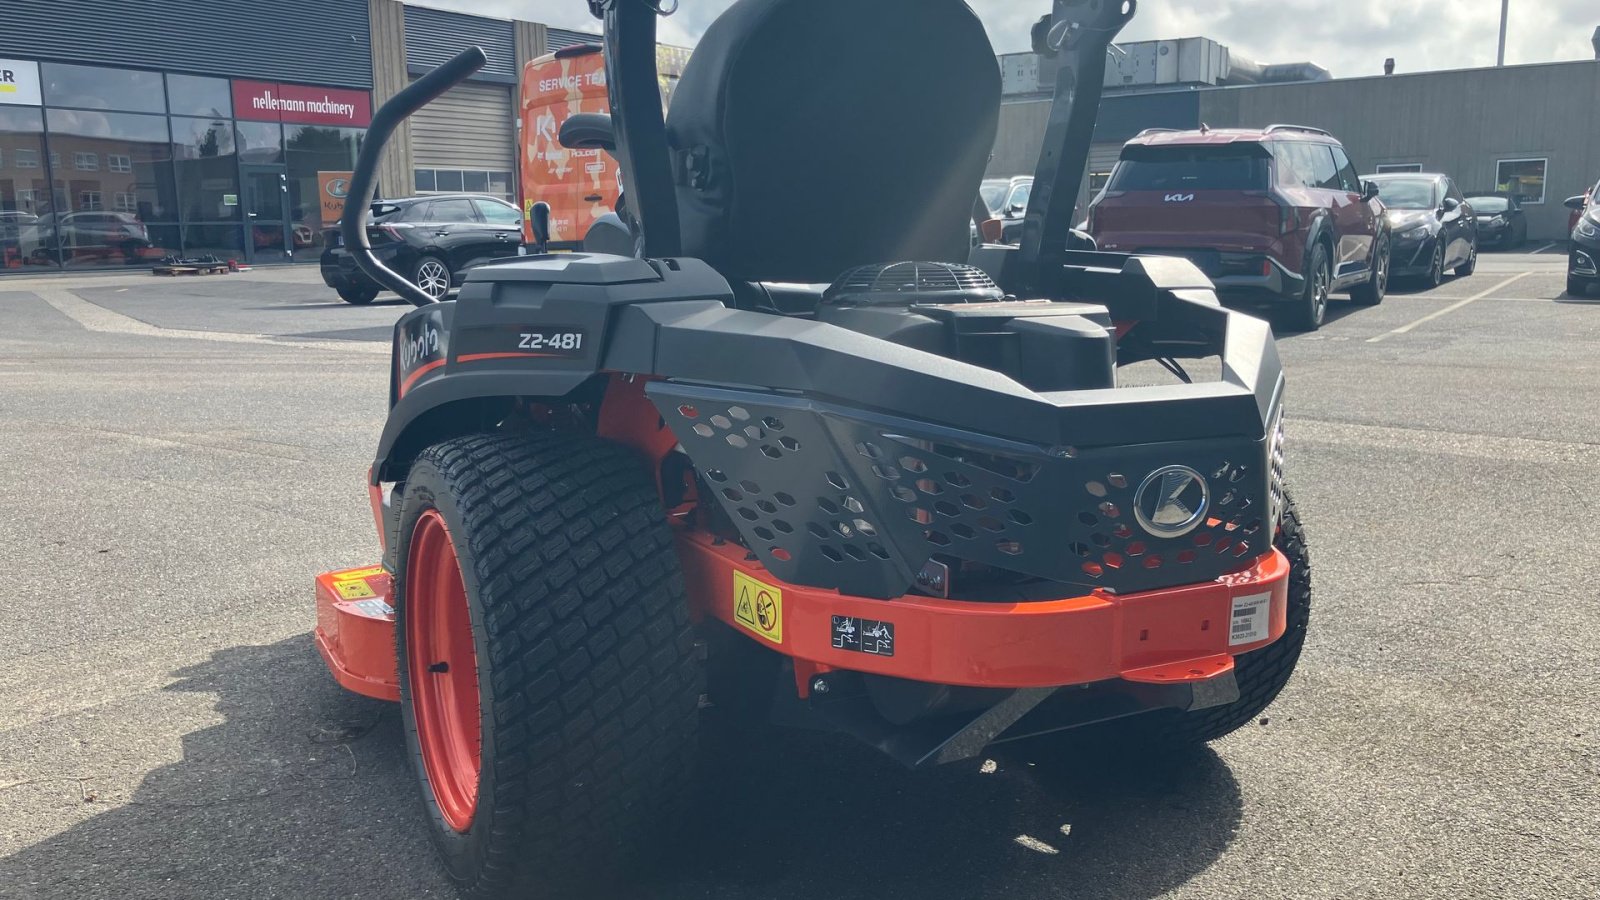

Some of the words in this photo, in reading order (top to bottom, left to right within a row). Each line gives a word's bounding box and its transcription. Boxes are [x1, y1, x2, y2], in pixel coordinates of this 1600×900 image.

[539, 75, 582, 92] SERVICE
[253, 91, 305, 112] nellemann
[307, 96, 354, 119] machinery
[400, 323, 439, 371] Kubota
[518, 333, 582, 350] Z2-481
